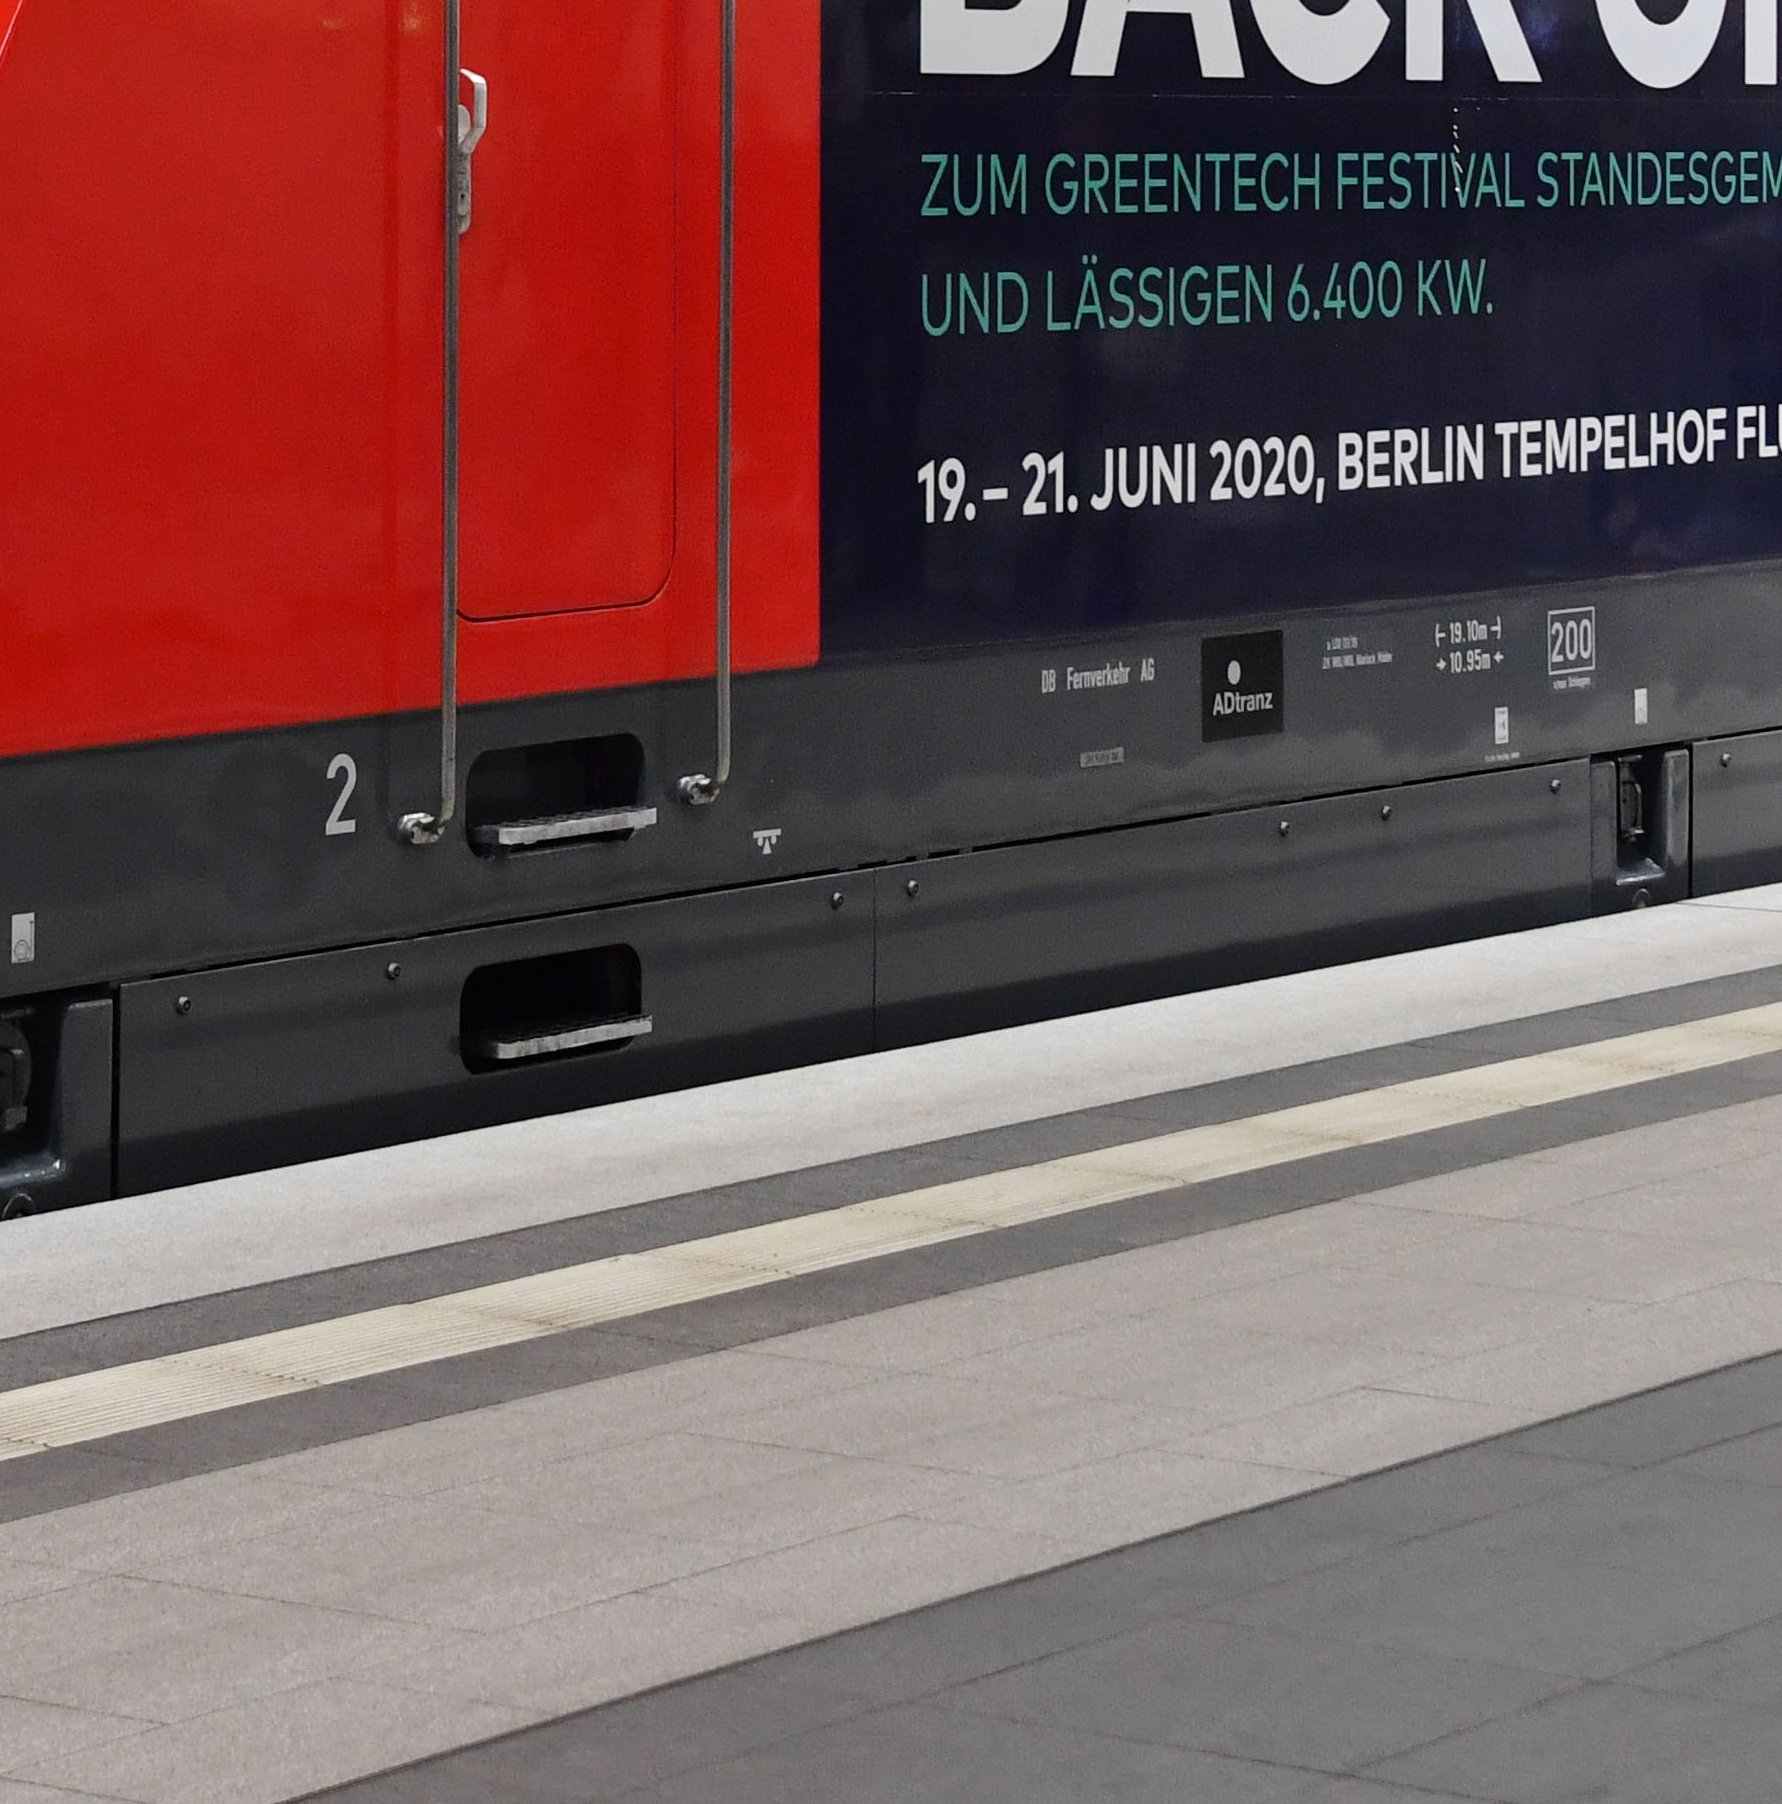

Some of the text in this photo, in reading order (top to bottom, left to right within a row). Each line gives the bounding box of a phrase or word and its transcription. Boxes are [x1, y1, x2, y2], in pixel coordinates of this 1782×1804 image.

[921, 152, 1027, 216] ZUM
[1044, 152, 1320, 214] GREENTECH
[1336, 151, 1525, 210] FESTIVAL
[921, 254, 1494, 336] UND LÄSSIGEN 6.400 KW.
[1022, 451, 1078, 516] 21.
[1090, 443, 1197, 511] JUNI
[1209, 434, 1325, 504] 2020,
[1337, 423, 1484, 491] BERLIN
[1495, 407, 1727, 478] TEMPELHOF
[1449, 619, 1488, 645] 19.10m
[1550, 618, 1592, 663] 200
[1041, 657, 1155, 694] DB Fernverkehr AG
[1449, 648, 1491, 674] 10.95m
[1212, 688, 1273, 718] ADtranz
[324, 752, 356, 837] 2
